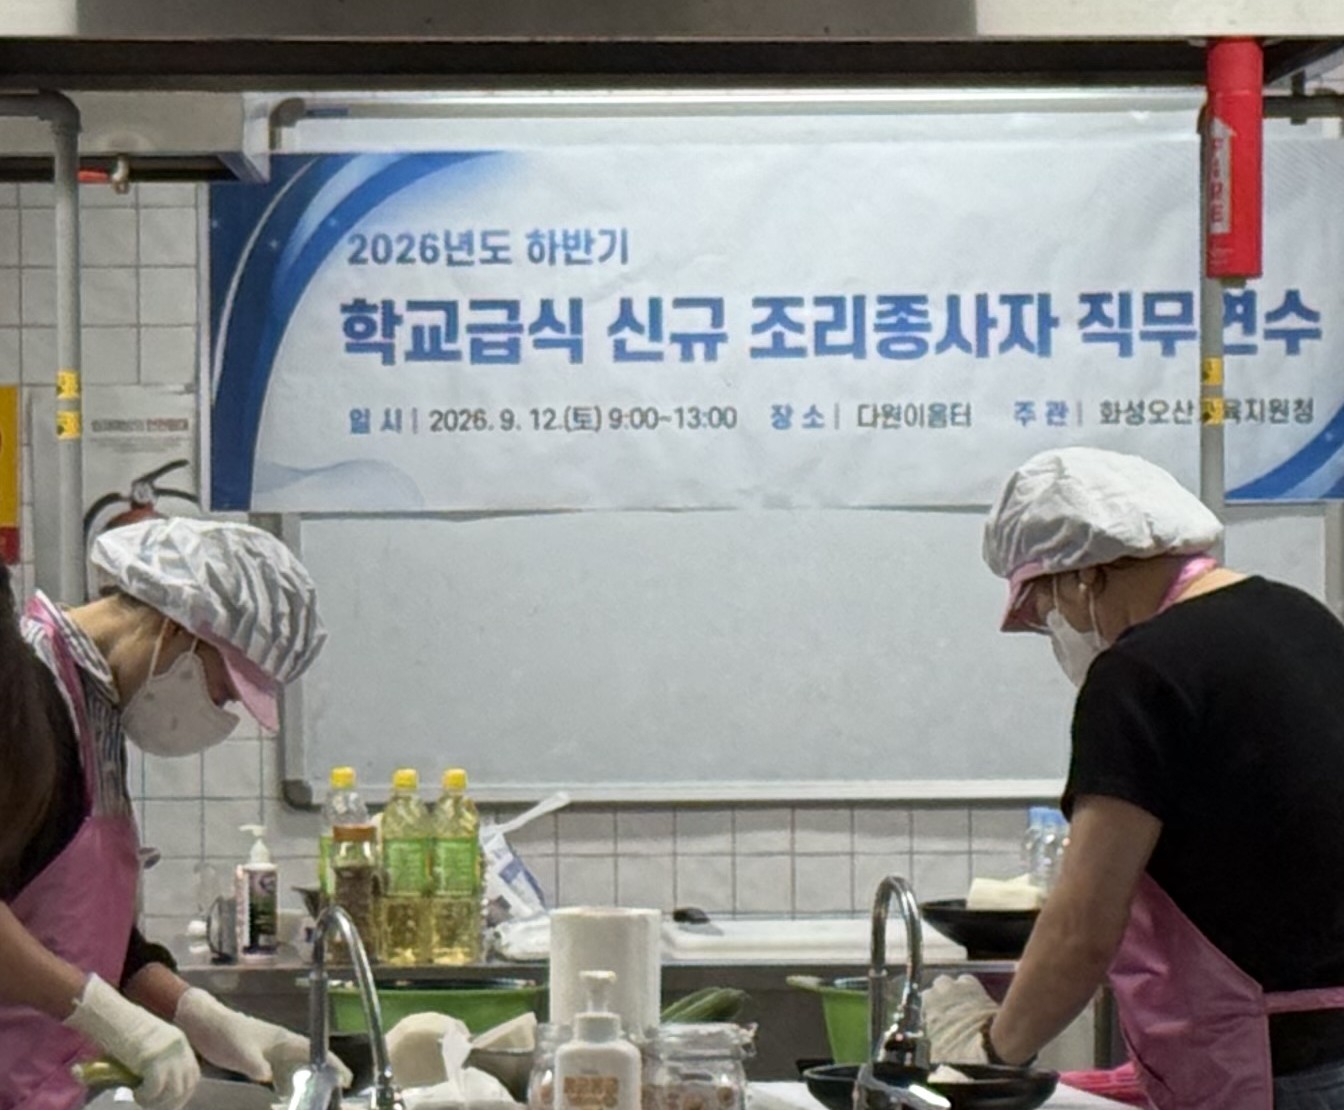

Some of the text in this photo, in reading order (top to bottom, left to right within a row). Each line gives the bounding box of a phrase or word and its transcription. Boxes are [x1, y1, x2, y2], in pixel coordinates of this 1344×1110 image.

[347, 228, 630, 266] 2026년도 하반기
[339, 296, 586, 366] 학교급식
[606, 296, 729, 363] 신규
[749, 292, 1060, 361] 조리종사자
[1098, 396, 1315, 426] 화성오산육지원청
